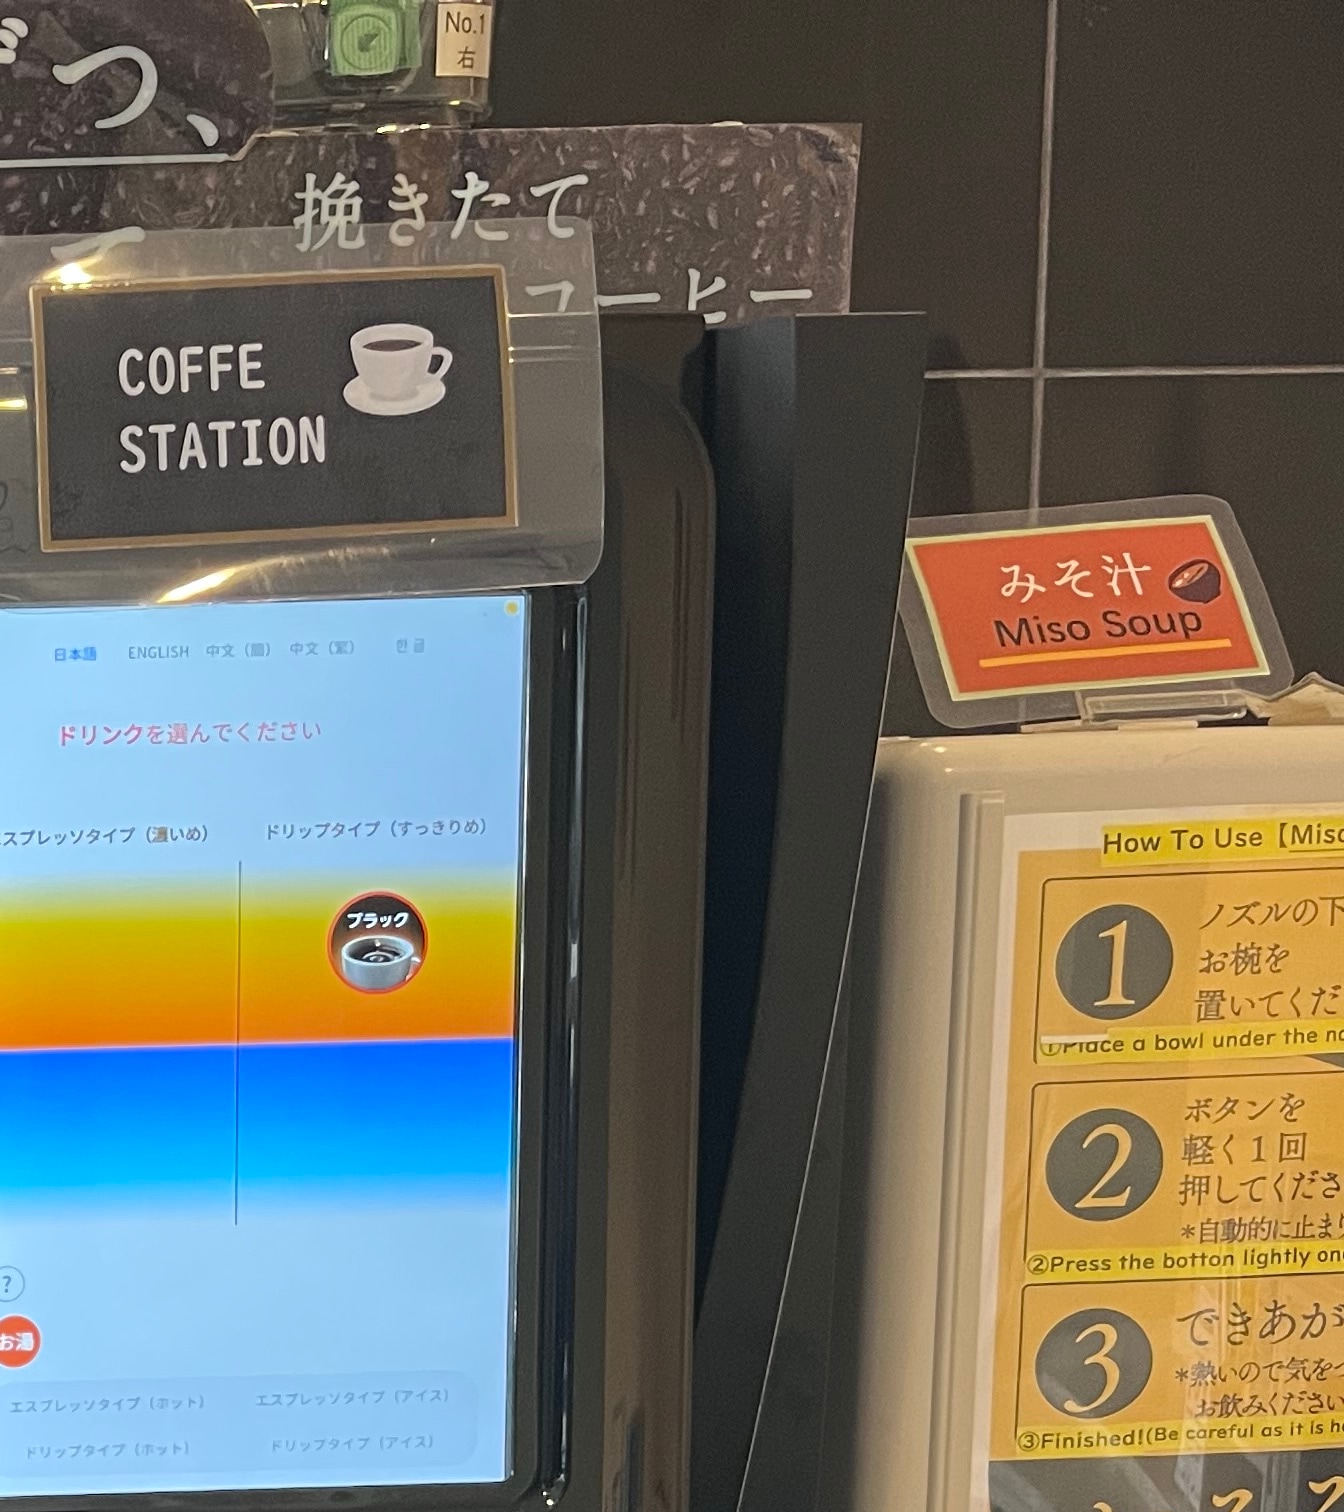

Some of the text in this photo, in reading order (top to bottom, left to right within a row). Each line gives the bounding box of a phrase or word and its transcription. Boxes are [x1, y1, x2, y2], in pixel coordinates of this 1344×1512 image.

[445, 11, 485, 35] No.1
[457, 46, 476, 69] 右
[293, 171, 589, 252] 挽きたて
[118, 342, 266, 396] COFFE
[118, 414, 327, 474] STATION
[1000, 551, 1152, 603] みそ汁
[993, 609, 1203, 648] Miso Soup
[54, 646, 97, 662] 日本語
[127, 645, 189, 660] ENGLISH
[59, 720, 322, 747] ドリンクを選んでください
[265, 817, 488, 842] ドリップタイプ（すっきりめ）
[1103, 832, 1161, 855] How
[1170, 829, 1204, 851] To
[1214, 827, 1263, 849] Use
[346, 911, 409, 929] ブラック
[1093, 919, 1136, 1007] 1
[1198, 941, 1290, 976] お椀を
[1195, 984, 1342, 1023] 置いてくだ
[1132, 1039, 1145, 1051] a
[1154, 1032, 1204, 1052] bowl
[1213, 1030, 1276, 1050] under
[1283, 1027, 1318, 1045] the
[1184, 1092, 1305, 1124] ボタンを
[1074, 1123, 1132, 1209] 2
[1178, 1169, 1341, 1207] 押してくださ
[1119, 1253, 1155, 1272] the
[1163, 1250, 1235, 1269] botton
[1243, 1246, 1311, 1270] lightly
[1063, 1323, 1120, 1413] 3
[255, 1387, 449, 1408] エスプレッソタイプ（アイス）
[270, 1433, 434, 1454] ドリップタイプ（アイス）
[1185, 1423, 1254, 1442] careful
[1261, 1425, 1282, 1437] as
[1290, 1421, 1304, 1436] it
[1310, 1420, 1324, 1435] is
